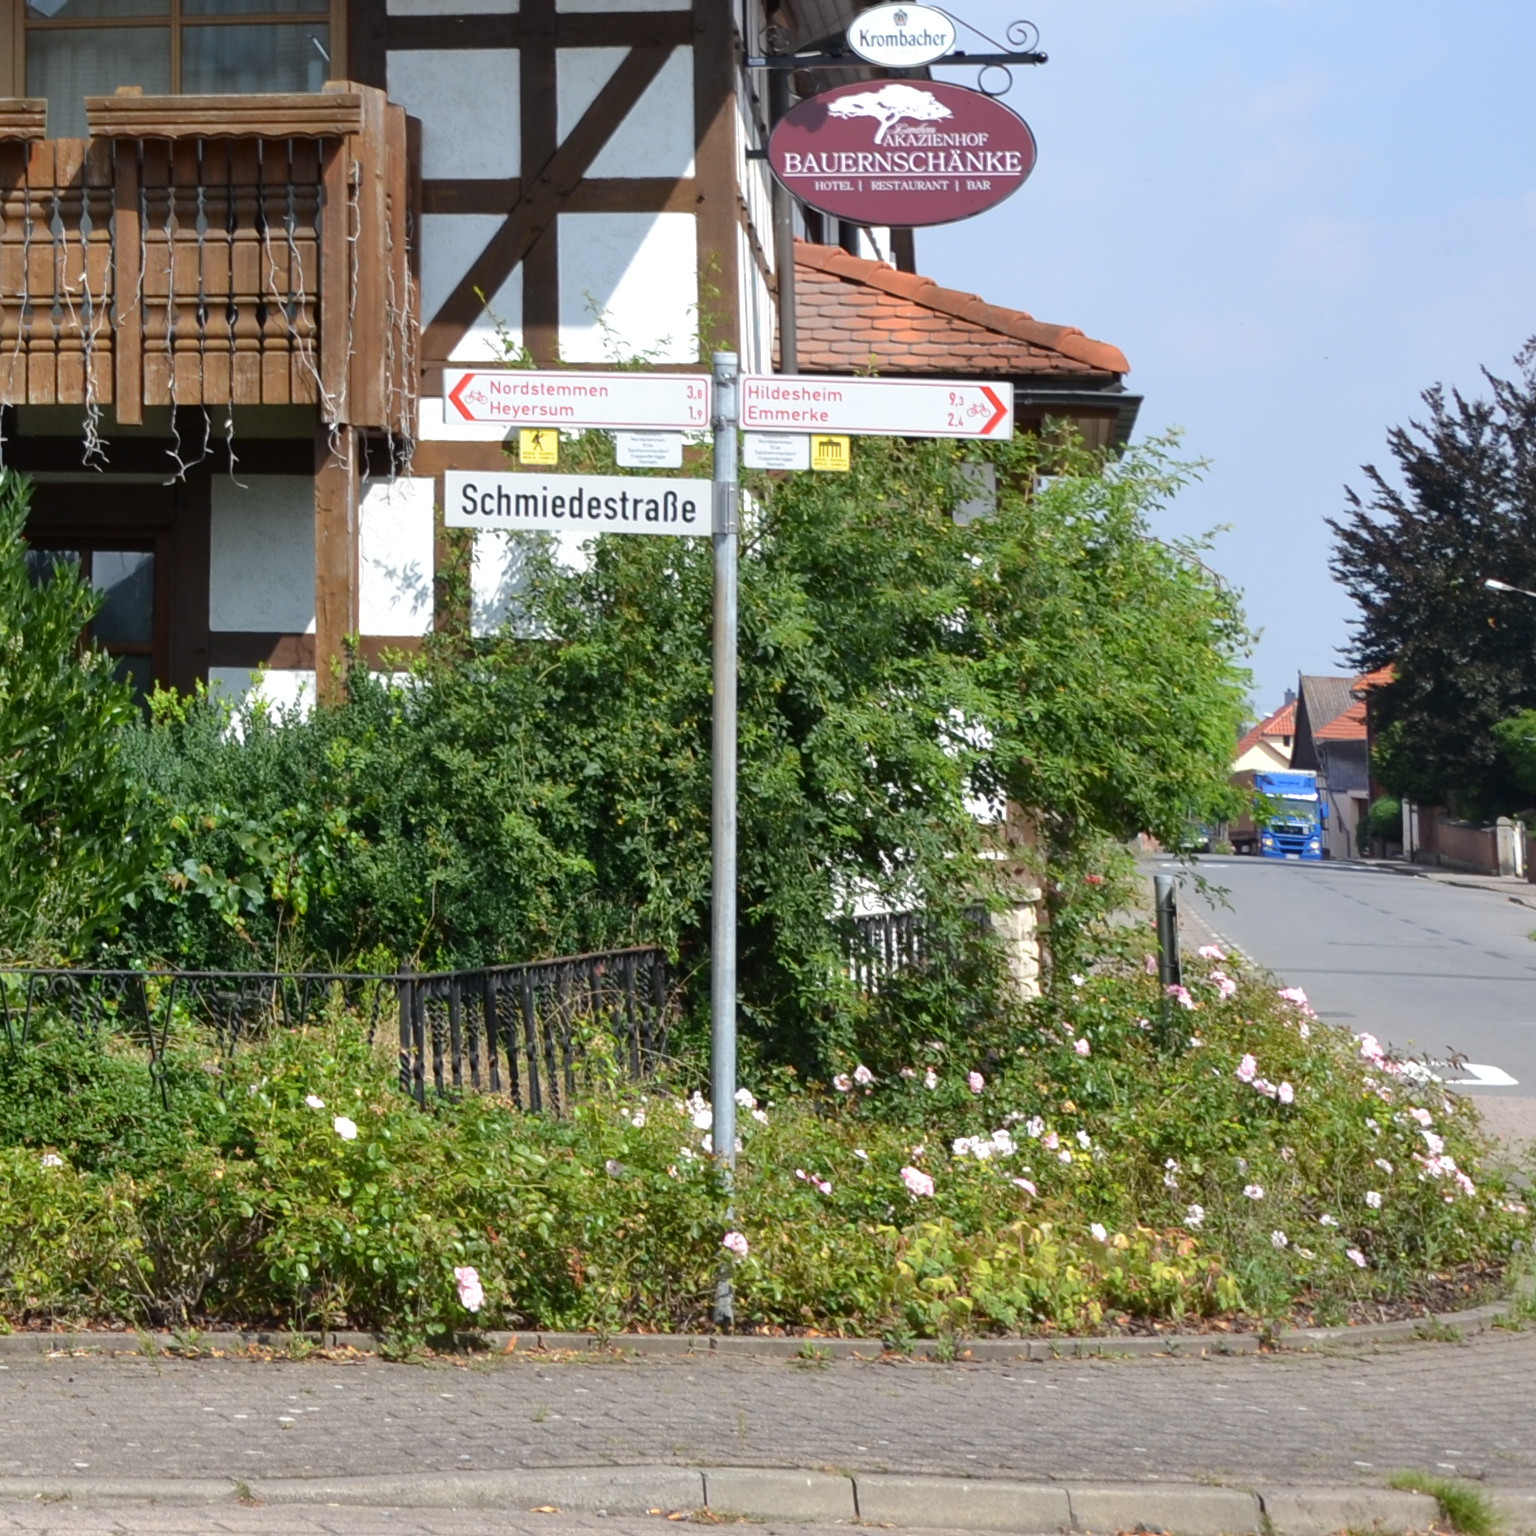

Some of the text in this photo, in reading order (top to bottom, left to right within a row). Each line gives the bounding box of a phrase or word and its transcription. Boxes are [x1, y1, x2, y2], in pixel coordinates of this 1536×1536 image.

[859, 28, 947, 47] Krombacher
[882, 132, 989, 147] AKAZIENHOF
[783, 149, 1023, 173] BAUERNSCHÄNKE
[814, 180, 992, 192] HOTEL RESTAURANT BAR
[489, 380, 609, 398] Nordstemmen
[748, 385, 843, 402] Hildesheim
[489, 400, 575, 419] Heyersum
[748, 405, 829, 422] Emmerke
[461, 483, 697, 524] Schmiedestraße
